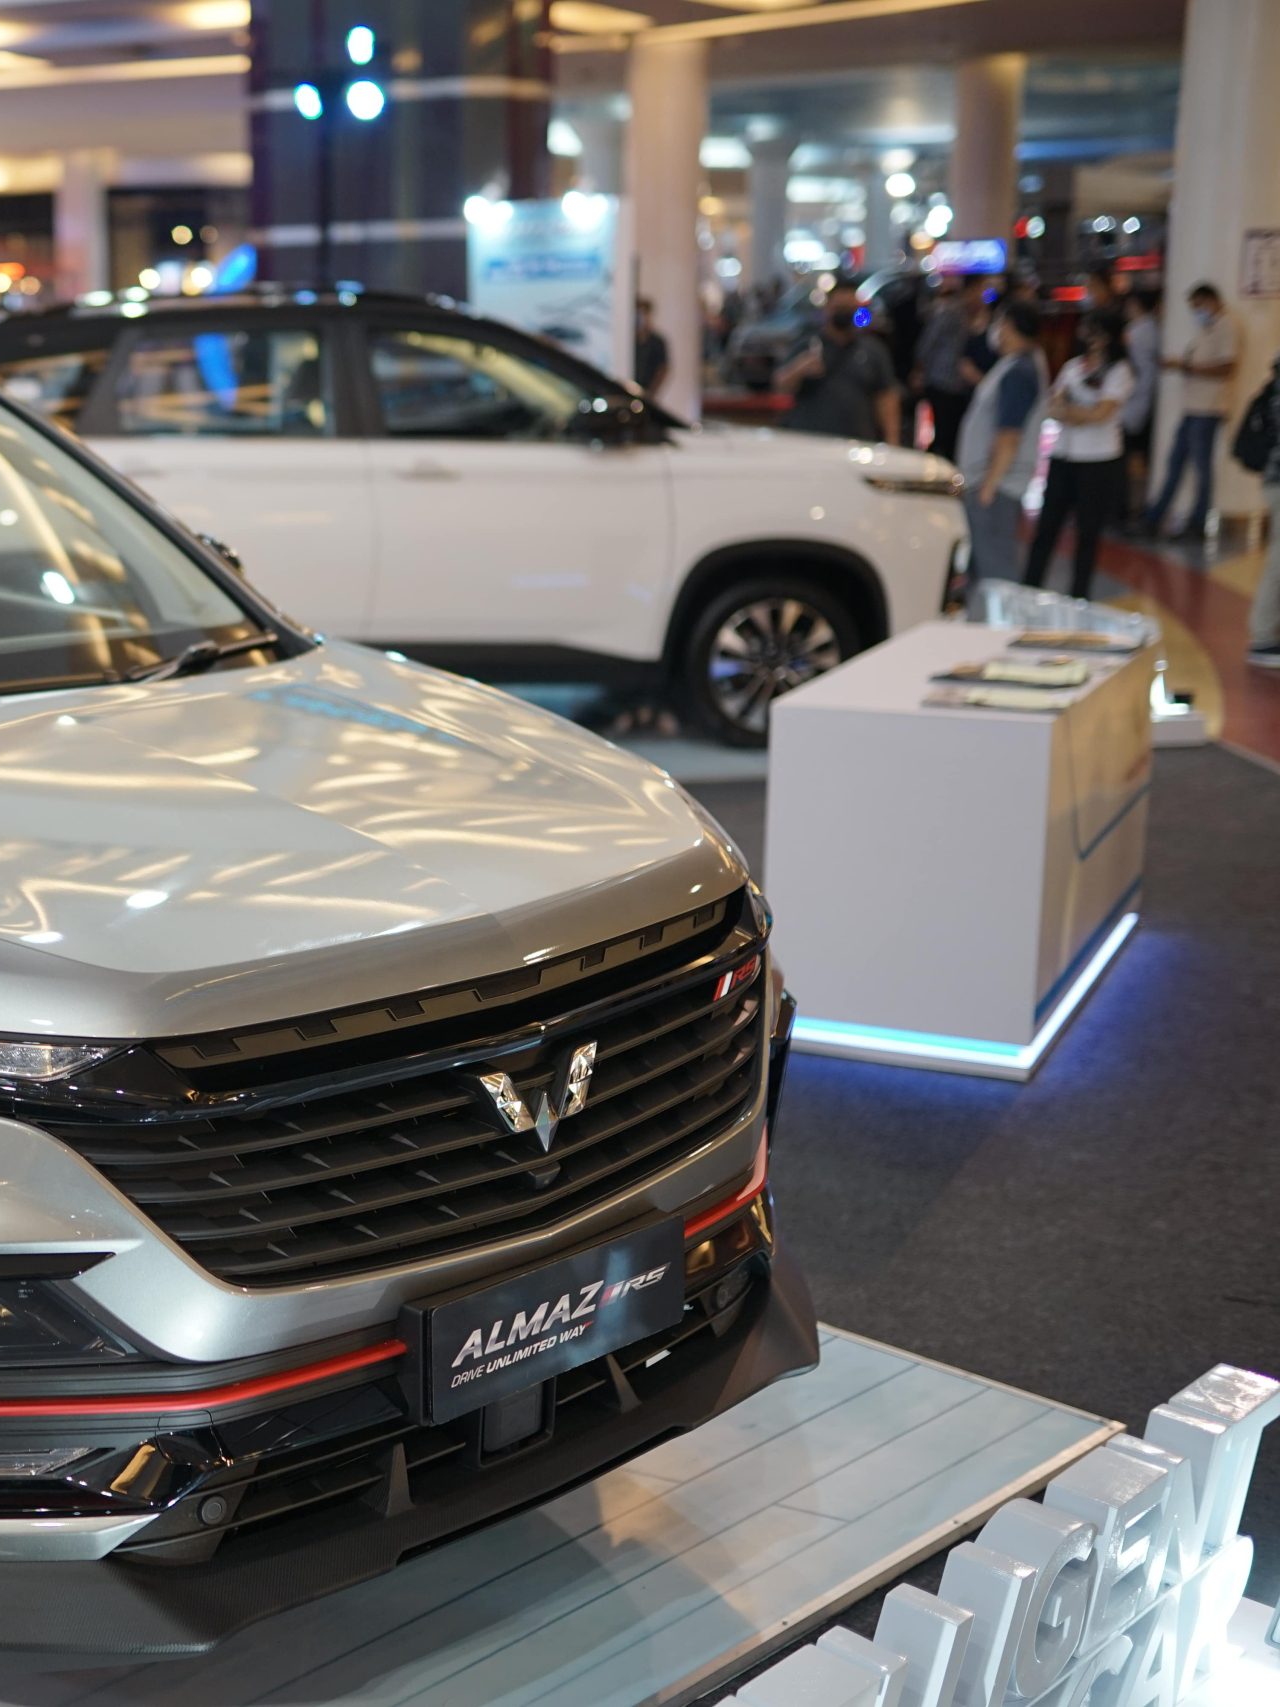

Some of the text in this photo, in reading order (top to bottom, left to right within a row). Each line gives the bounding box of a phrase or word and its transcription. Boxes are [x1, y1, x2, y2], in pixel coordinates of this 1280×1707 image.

[450, 1322, 593, 1388] DRIVE UNLIMITED WAY
[451, 1262, 672, 1368] ALMAZ RS
